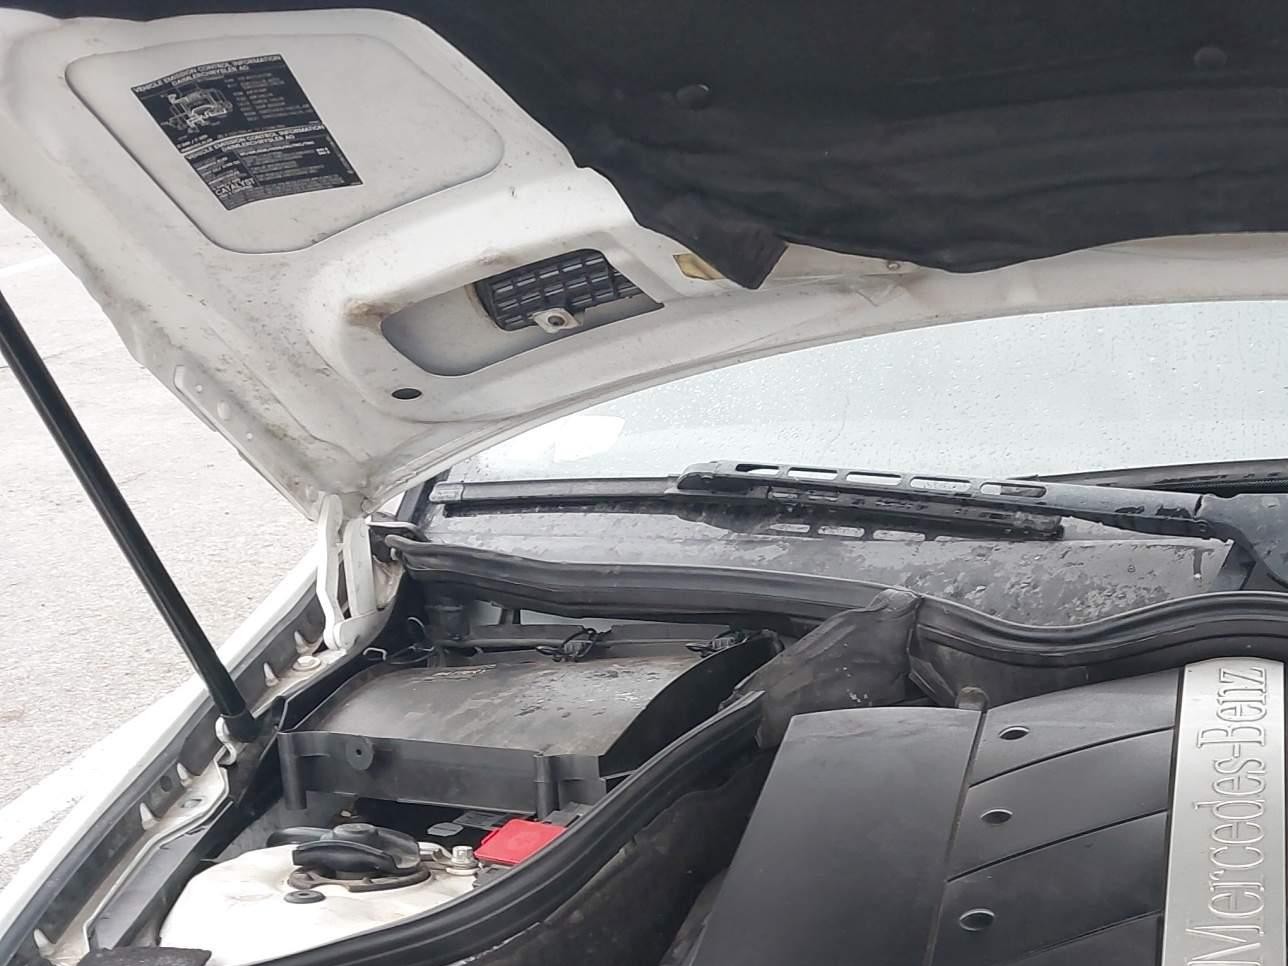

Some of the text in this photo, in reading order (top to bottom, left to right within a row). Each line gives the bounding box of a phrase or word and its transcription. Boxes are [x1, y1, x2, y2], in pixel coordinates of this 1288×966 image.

[133, 80, 163, 93] VEHICLE
[231, 55, 281, 67] INFORMATION
[215, 176, 256, 196] CATALYST
